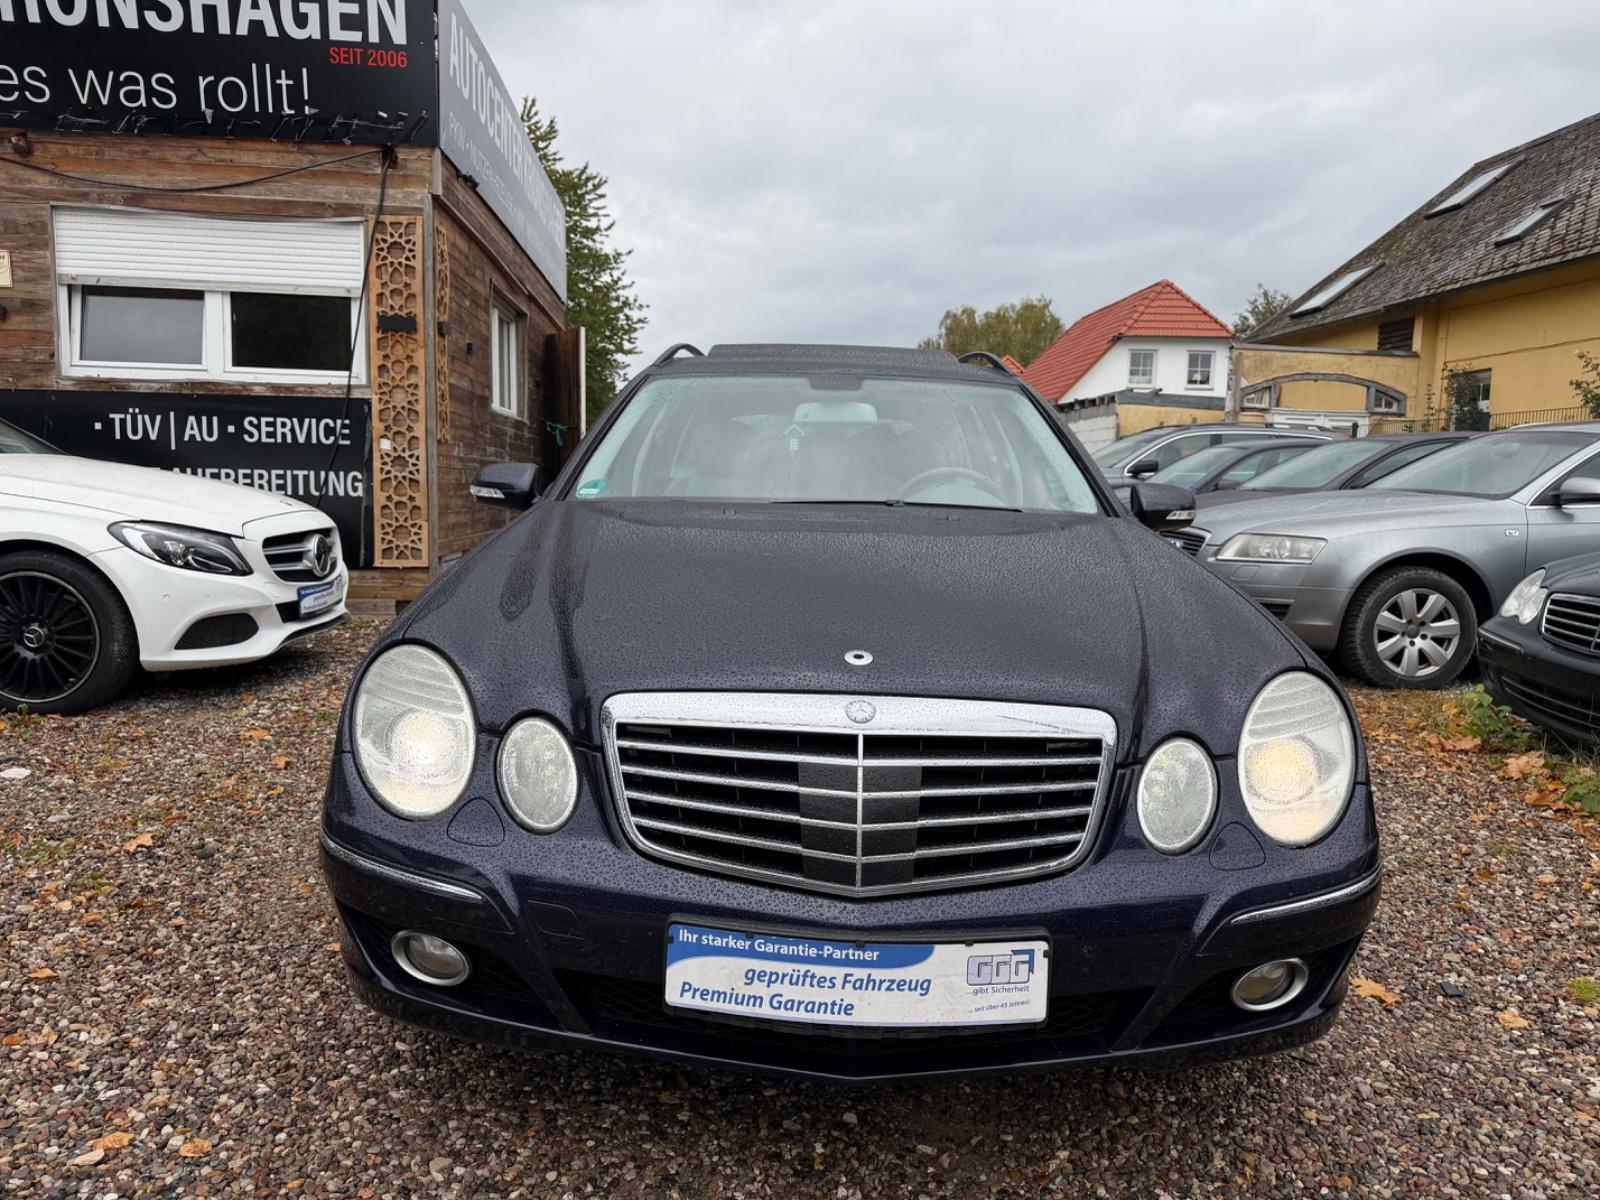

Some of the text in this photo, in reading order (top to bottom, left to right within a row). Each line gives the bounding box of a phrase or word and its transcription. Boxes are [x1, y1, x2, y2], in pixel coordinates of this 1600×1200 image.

[329, 47, 408, 68] SEIT 2006
[67, 68, 178, 110] was
[198, 62, 310, 115] rollt!
[449, 11, 523, 188] AUTOCENTER
[109, 408, 351, 445] TÜV AU SERVICE
[171, 466, 363, 497] BEREITUNG
[679, 929, 880, 961] Ihr starker Garantie-Partner
[744, 968, 932, 996] geprüftes Fahrzeug
[991, 985, 1030, 993] Sicherheit
[680, 981, 855, 1016] Premium Garantie
